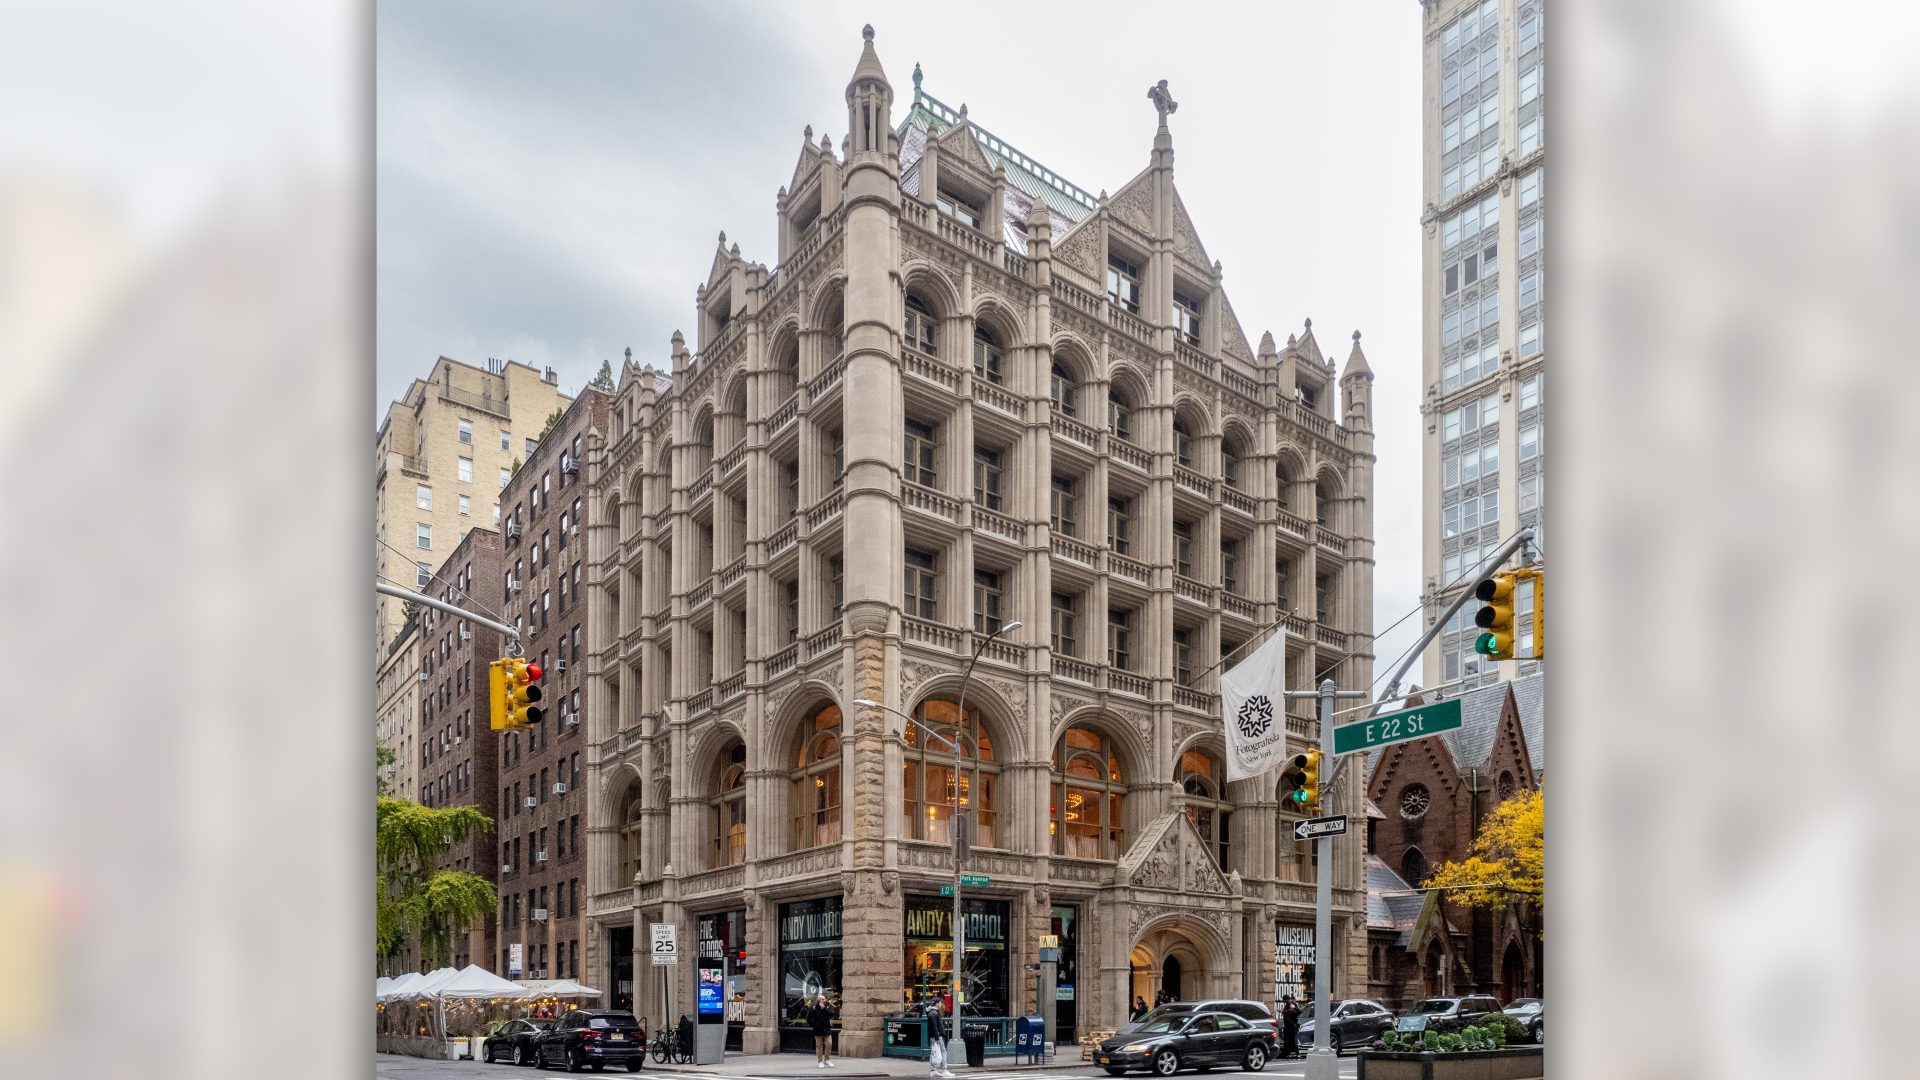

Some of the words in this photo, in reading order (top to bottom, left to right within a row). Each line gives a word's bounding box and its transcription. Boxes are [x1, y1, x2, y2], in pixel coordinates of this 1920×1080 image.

[1366, 725, 1376, 743] E
[1381, 719, 1401, 740] 22
[1407, 714, 1424, 733] St
[1236, 733, 1280, 755] Fotografiska
[1246, 756, 1259, 764] New
[1260, 749, 1272, 759] York
[1301, 825, 1317, 834] ONE
[1325, 821, 1342, 831] WAY
[700, 920, 713, 940] FIVE
[782, 915, 805, 942] ANDY
[806, 911, 841, 939] WARHO
[907, 909, 944, 937] ANDY
[655, 940, 674, 952] 25
[1279, 926, 1313, 946] MUSEUM
[1275, 945, 1316, 965] XPERIENCE
[1275, 964, 1286, 982] OR
[1288, 965, 1303, 983] THE
